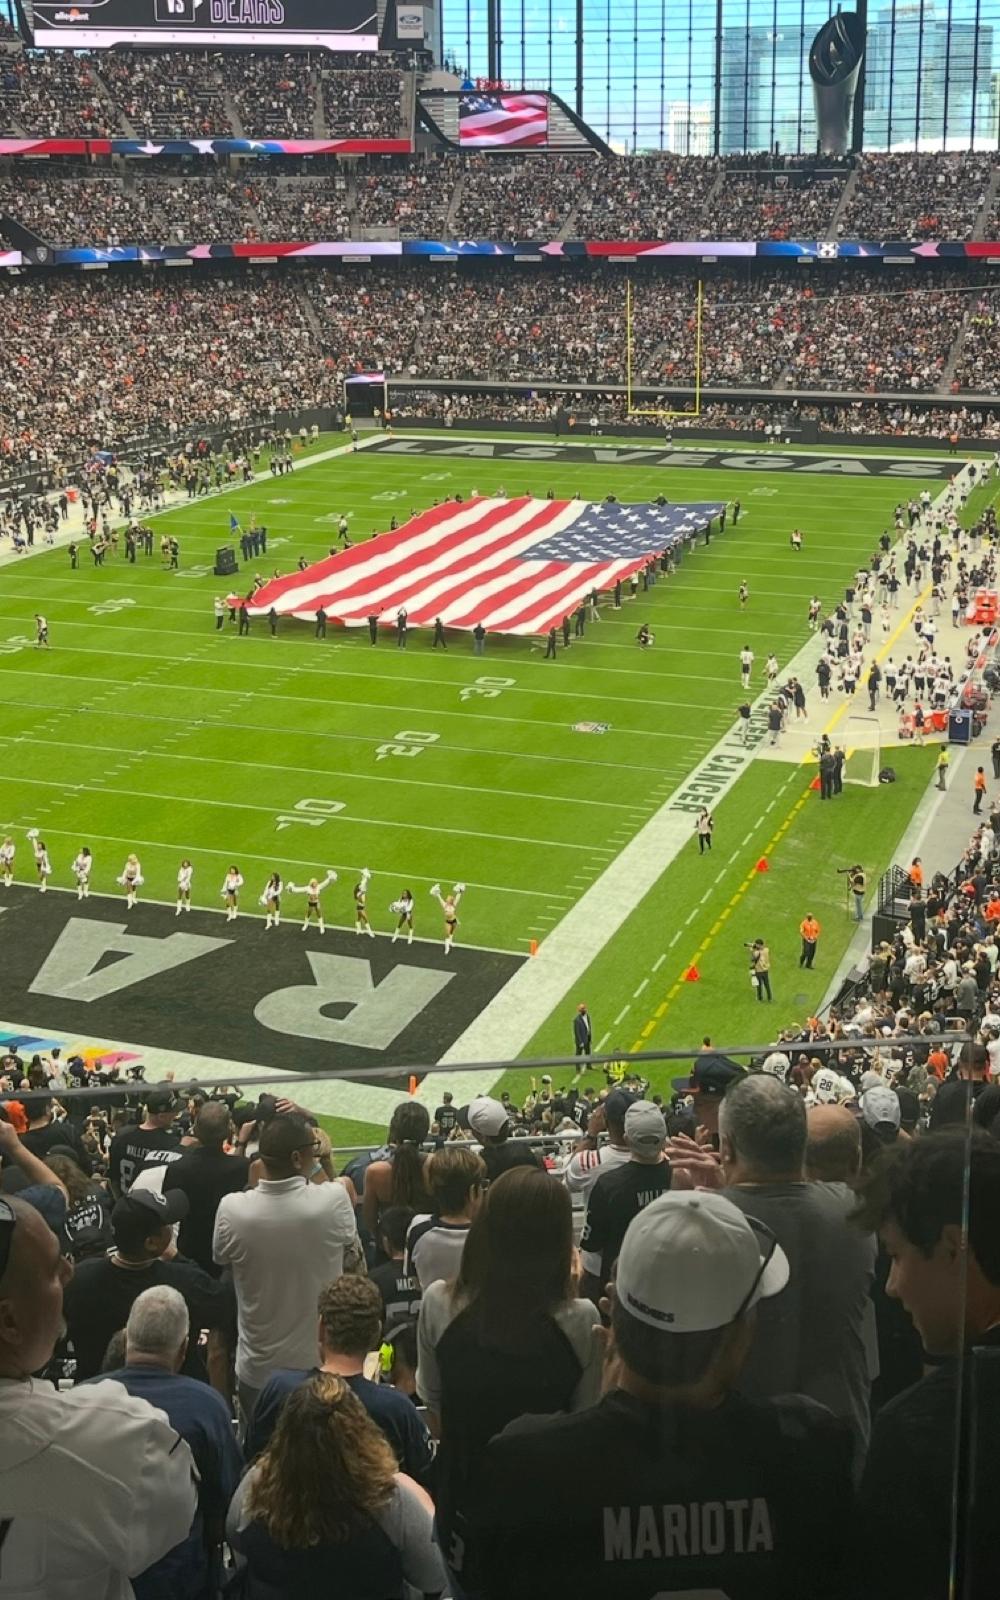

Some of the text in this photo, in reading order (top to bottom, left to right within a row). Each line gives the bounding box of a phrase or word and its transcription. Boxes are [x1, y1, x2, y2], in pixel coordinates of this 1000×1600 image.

[210, 0, 285, 24] BEARS
[377, 441, 568, 459] LAS
[594, 449, 946, 477] VEGAS
[460, 676, 517, 698] 30
[376, 730, 441, 758] 20
[669, 754, 745, 814] CANCER
[275, 798, 347, 827] 10
[819, 1078, 834, 1091] 28
[603, 1498, 774, 1561] MARIOTA
